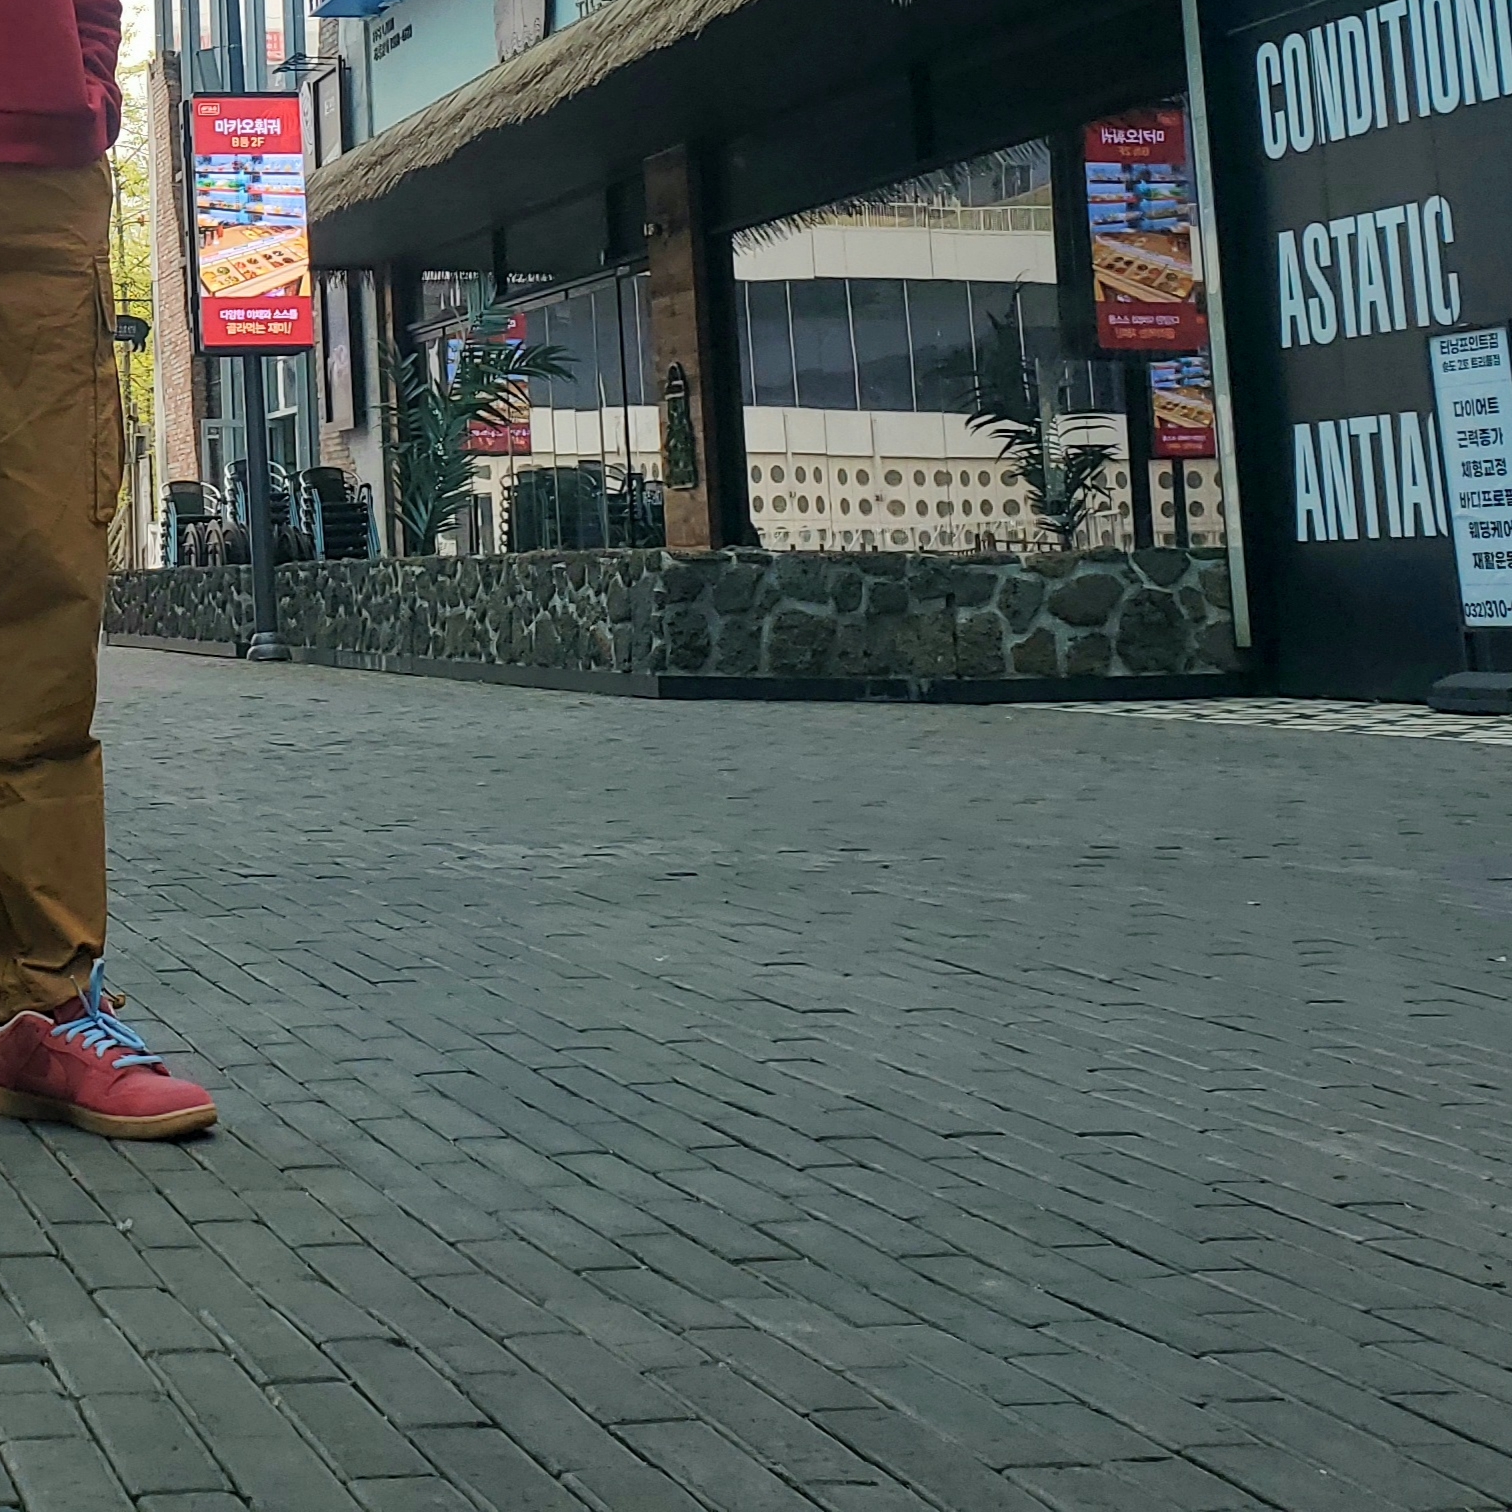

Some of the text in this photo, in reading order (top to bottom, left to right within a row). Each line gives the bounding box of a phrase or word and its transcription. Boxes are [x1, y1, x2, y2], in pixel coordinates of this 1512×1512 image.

[250, 136, 265, 148] 2F
[1278, 194, 1461, 348] ASTATIC
[1440, 332, 1499, 355] 터닝포인트짐
[1453, 396, 1500, 418] 다이어트
[1456, 427, 1504, 449] 근력증가
[1461, 457, 1507, 478] 체형교정
[1465, 599, 1512, 618] 032)310-
